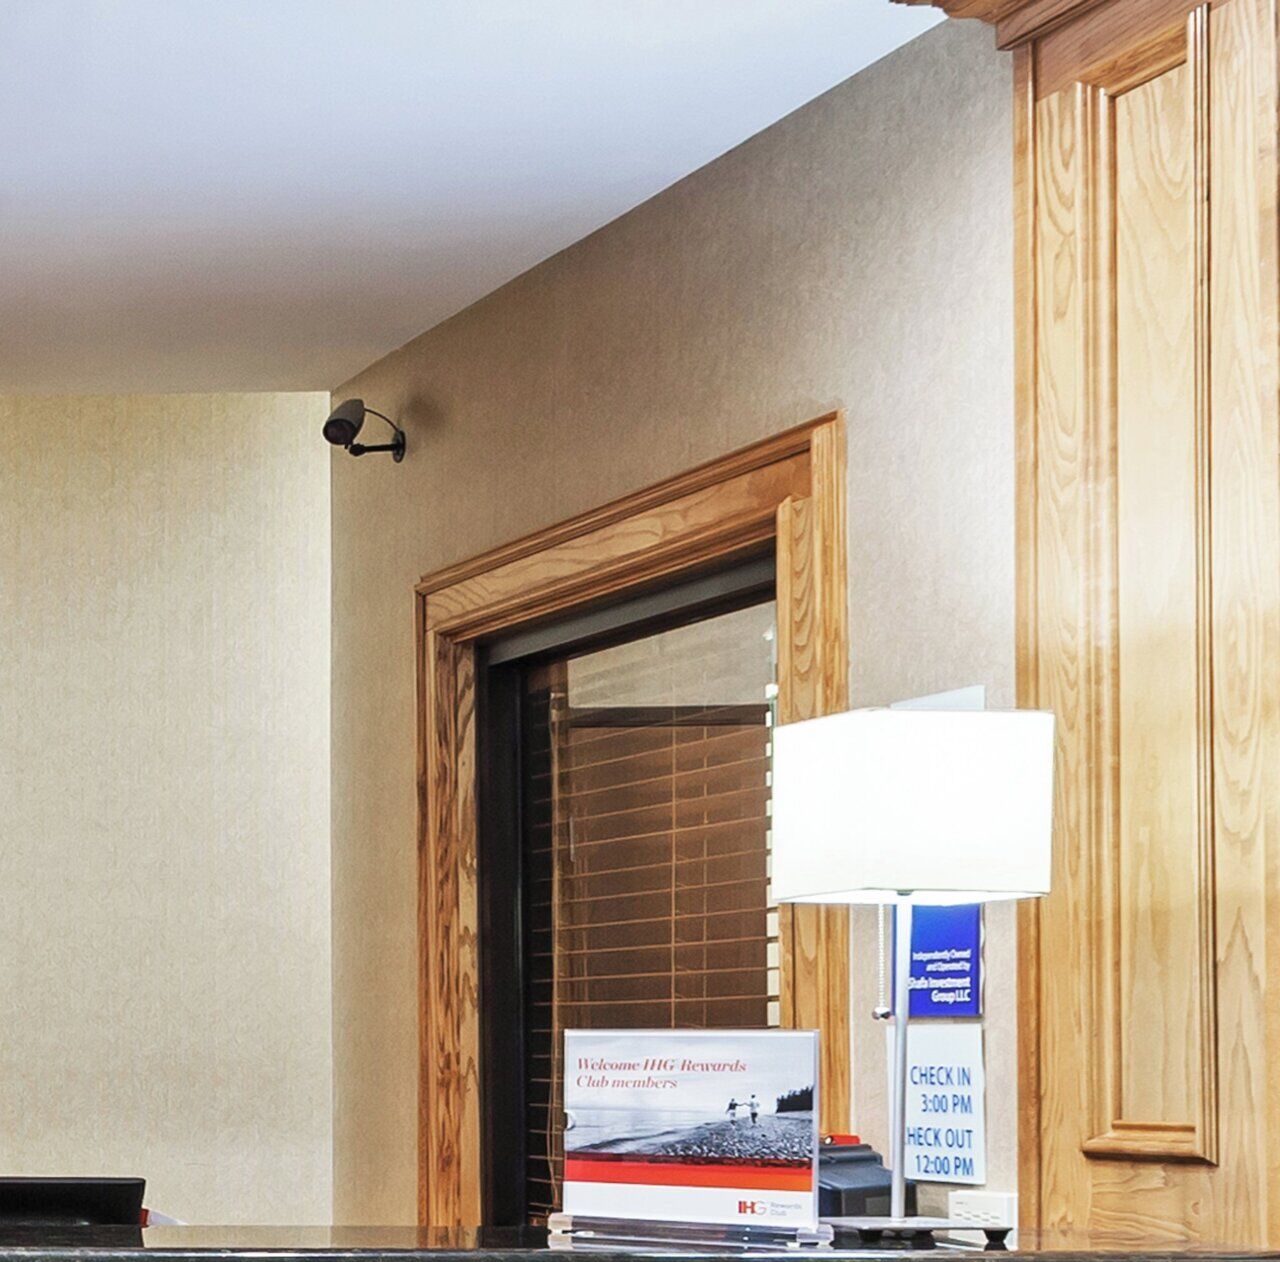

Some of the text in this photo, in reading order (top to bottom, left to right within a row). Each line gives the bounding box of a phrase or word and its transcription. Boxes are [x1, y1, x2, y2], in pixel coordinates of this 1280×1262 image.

[578, 1058, 640, 1071] Welcome
[680, 1059, 747, 1073] Rewards
[576, 1075, 678, 1089] Club members
[910, 1066, 971, 1086] CHECK IN
[921, 1094, 973, 1113] 3:00 PM
[905, 1127, 973, 1149] HECK OUT
[915, 1155, 974, 1176] 12:00 PM
[738, 1200, 767, 1215] IHG
